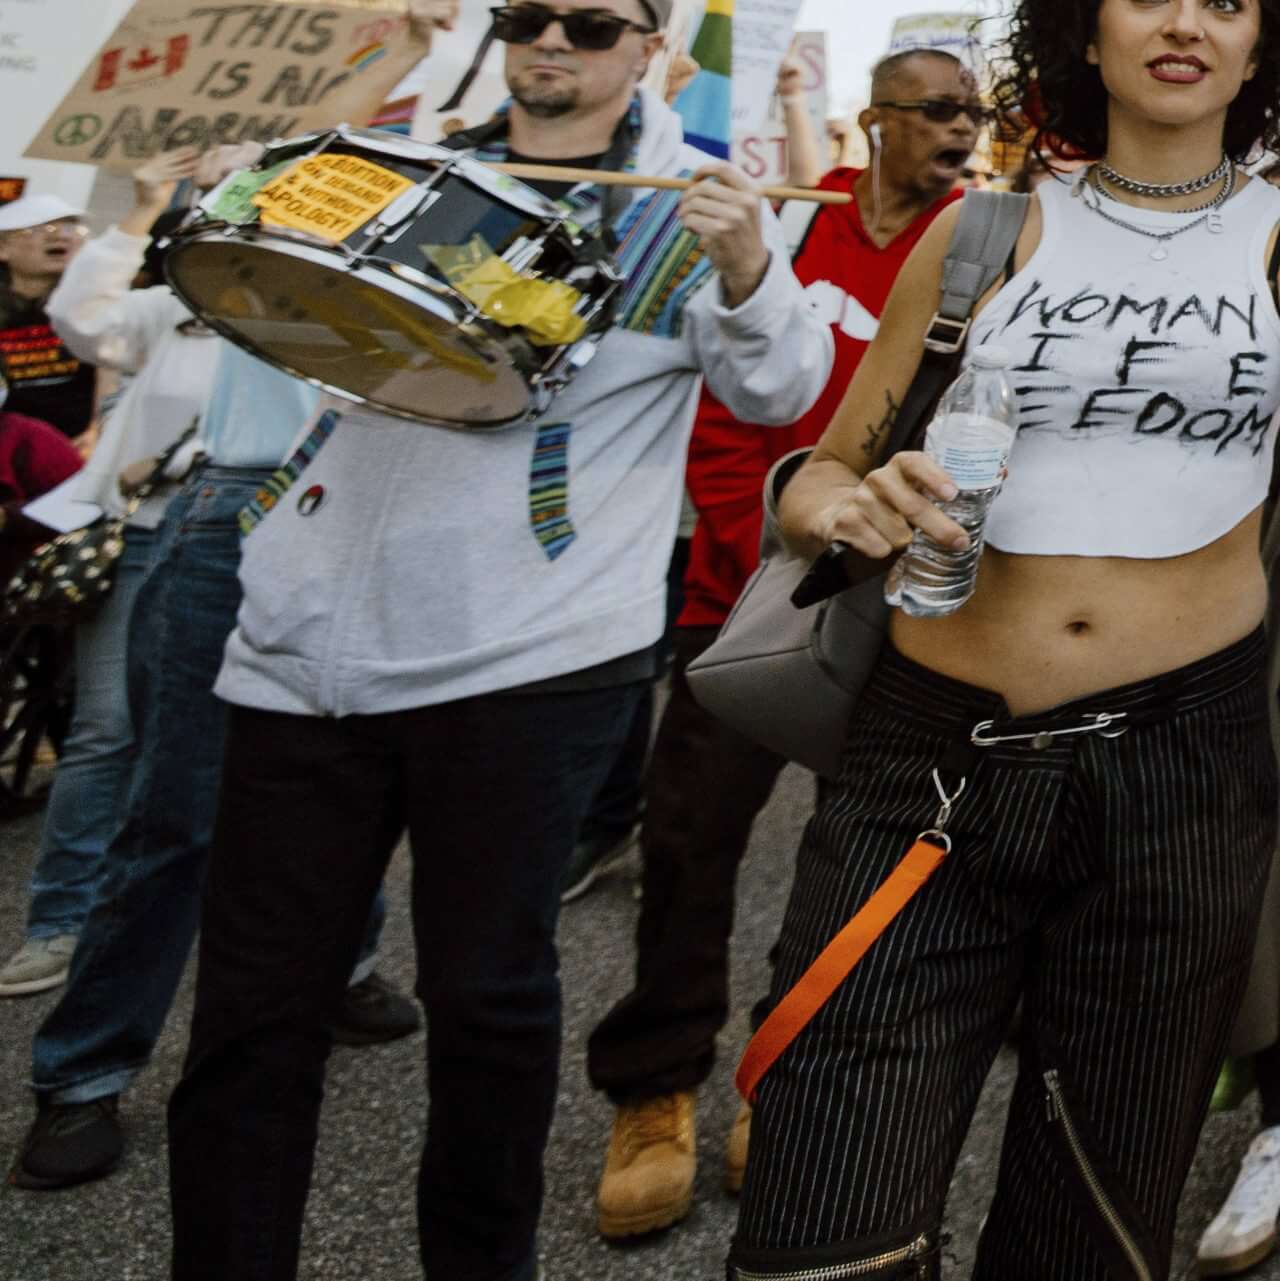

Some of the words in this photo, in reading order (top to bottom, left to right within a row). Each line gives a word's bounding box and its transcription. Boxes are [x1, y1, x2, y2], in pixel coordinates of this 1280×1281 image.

[188, 4, 338, 55] THIS
[193, 61, 250, 100] IS
[299, 183, 368, 216] WITHOUT
[1000, 279, 1257, 341] WOMAN
